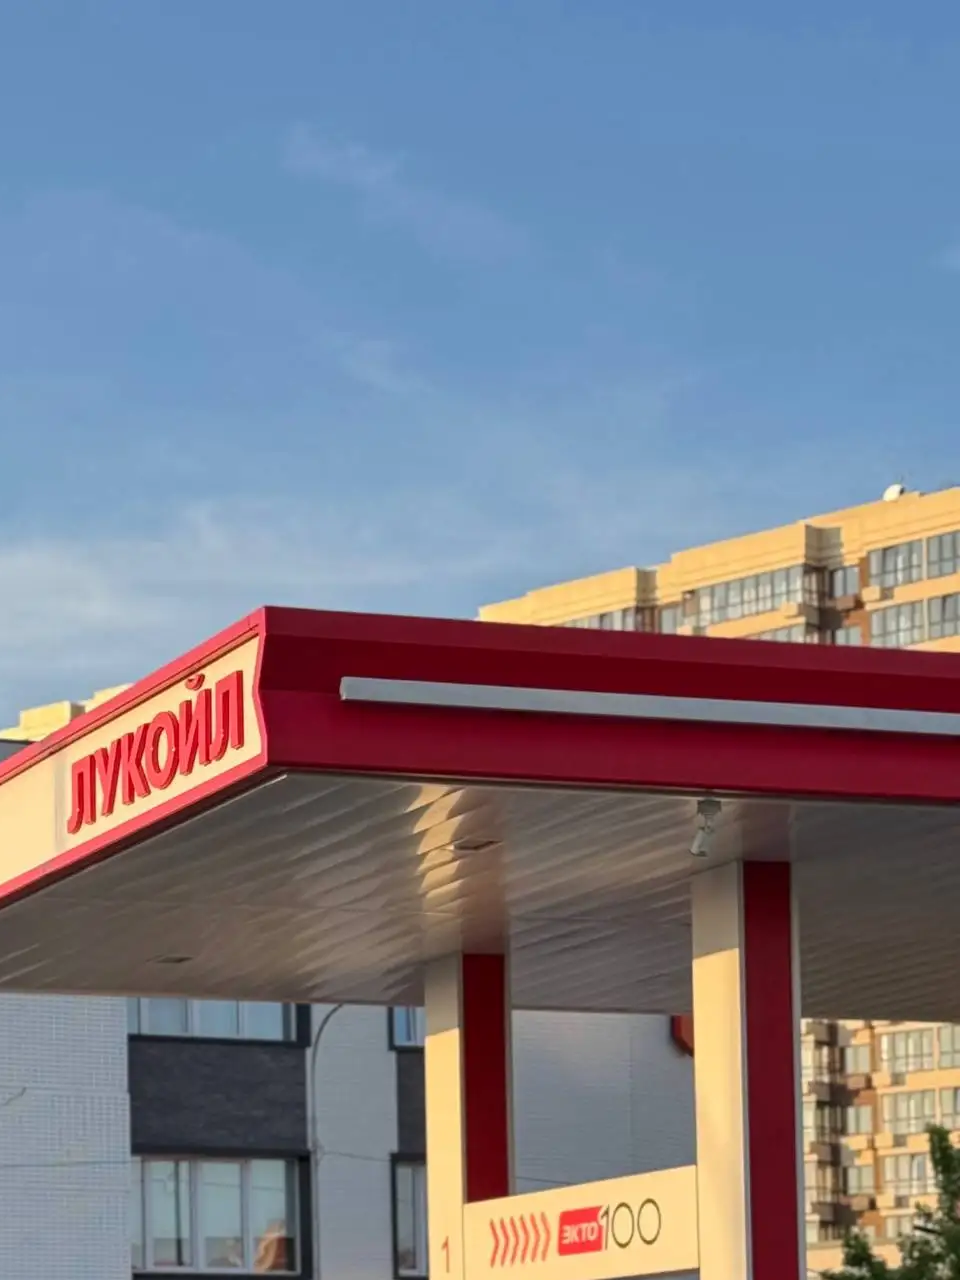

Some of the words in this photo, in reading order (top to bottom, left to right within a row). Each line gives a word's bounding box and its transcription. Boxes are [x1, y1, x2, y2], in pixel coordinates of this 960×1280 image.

[67, 670, 244, 834] ЛУКОЙЛ
[561, 1221, 598, 1245] ЭКТО
[601, 1198, 661, 1250] 100
